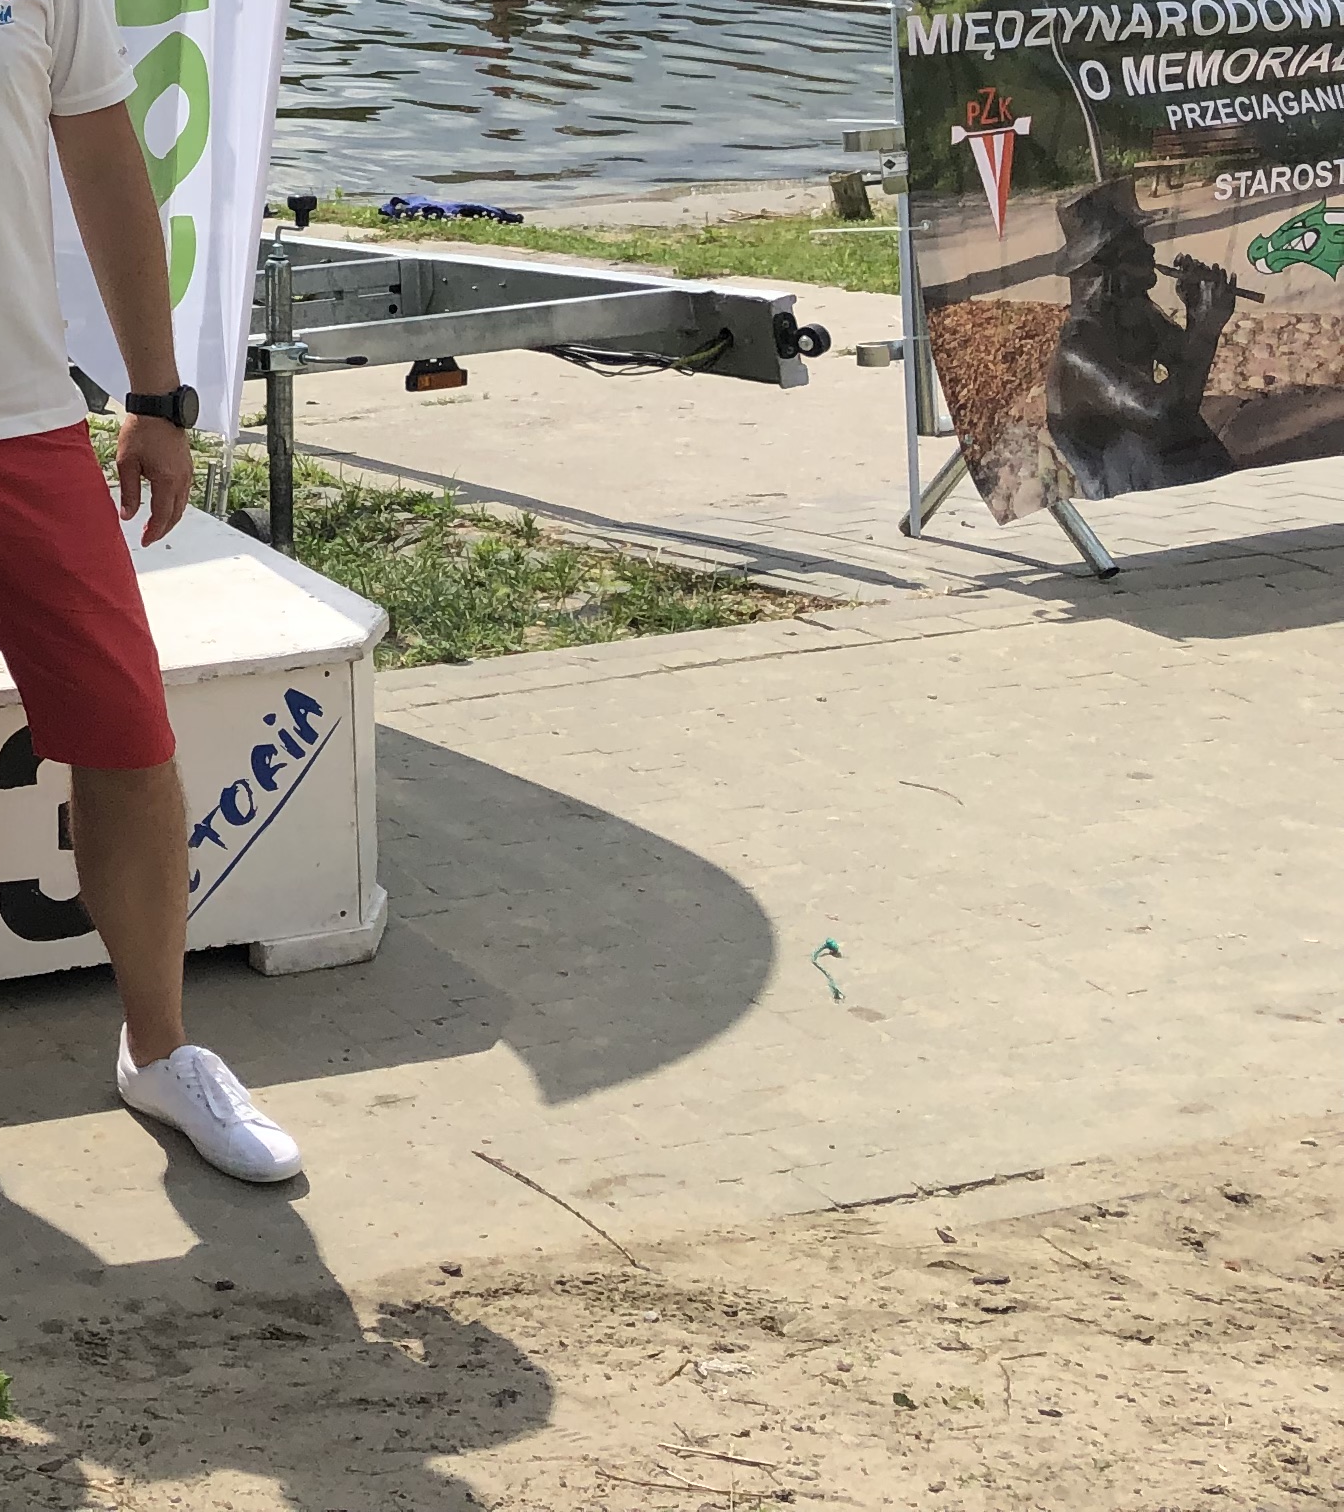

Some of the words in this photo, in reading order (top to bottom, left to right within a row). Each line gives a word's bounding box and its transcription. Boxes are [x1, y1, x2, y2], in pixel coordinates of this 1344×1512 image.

[1078, 60, 1110, 101] O
[966, 87, 1014, 126] PZK
[1166, 84, 1344, 131] PRZECIĄGANI
